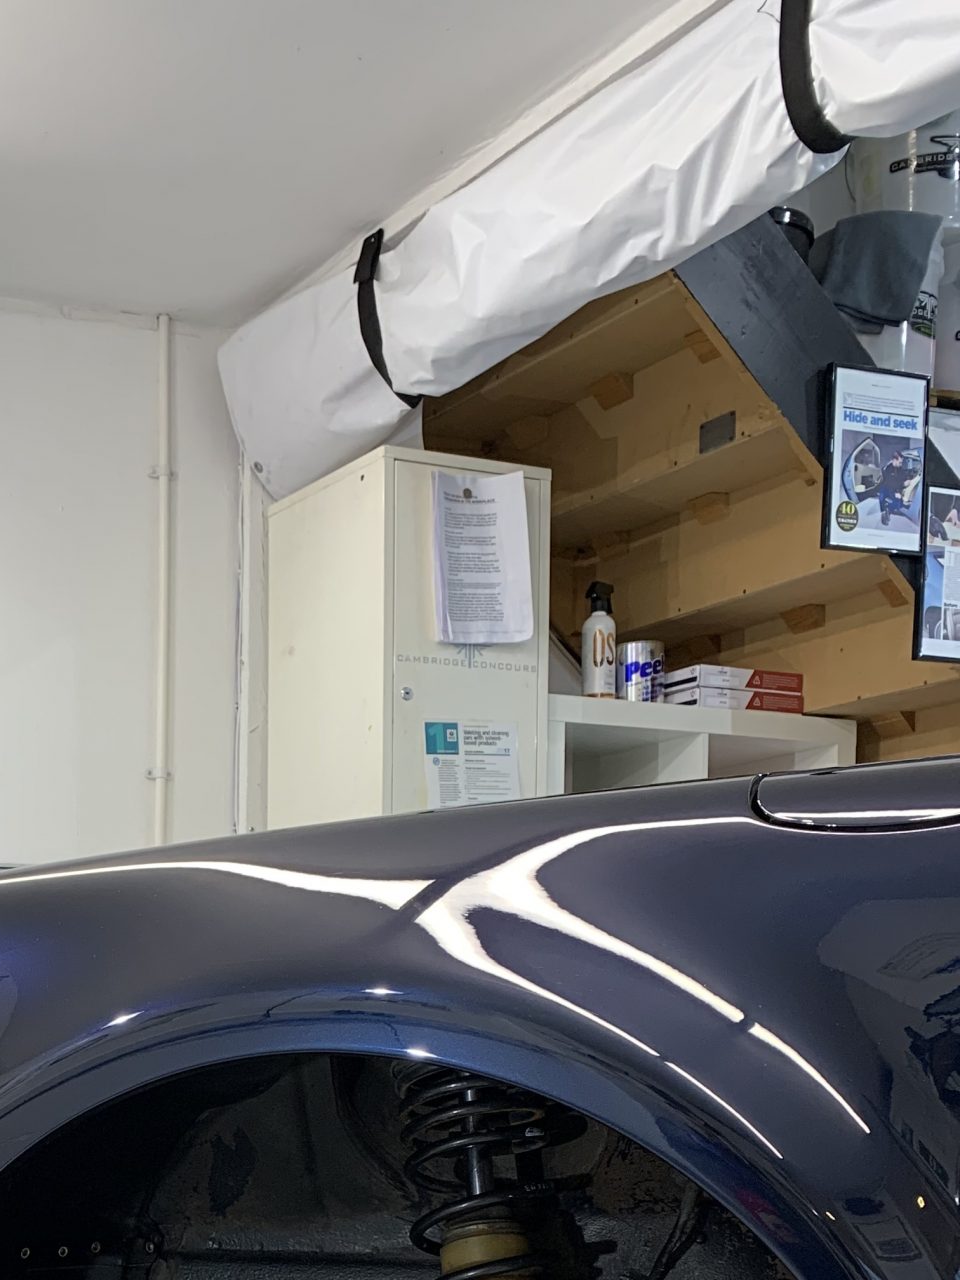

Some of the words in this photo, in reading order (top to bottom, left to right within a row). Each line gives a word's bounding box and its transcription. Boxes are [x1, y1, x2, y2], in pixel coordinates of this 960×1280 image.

[843, 410, 868, 424] Hide
[871, 416, 891, 427] and
[893, 419, 918, 430] seek
[396, 654, 467, 667] CAMBRIDGE
[472, 660, 537, 673] CONCOURS
